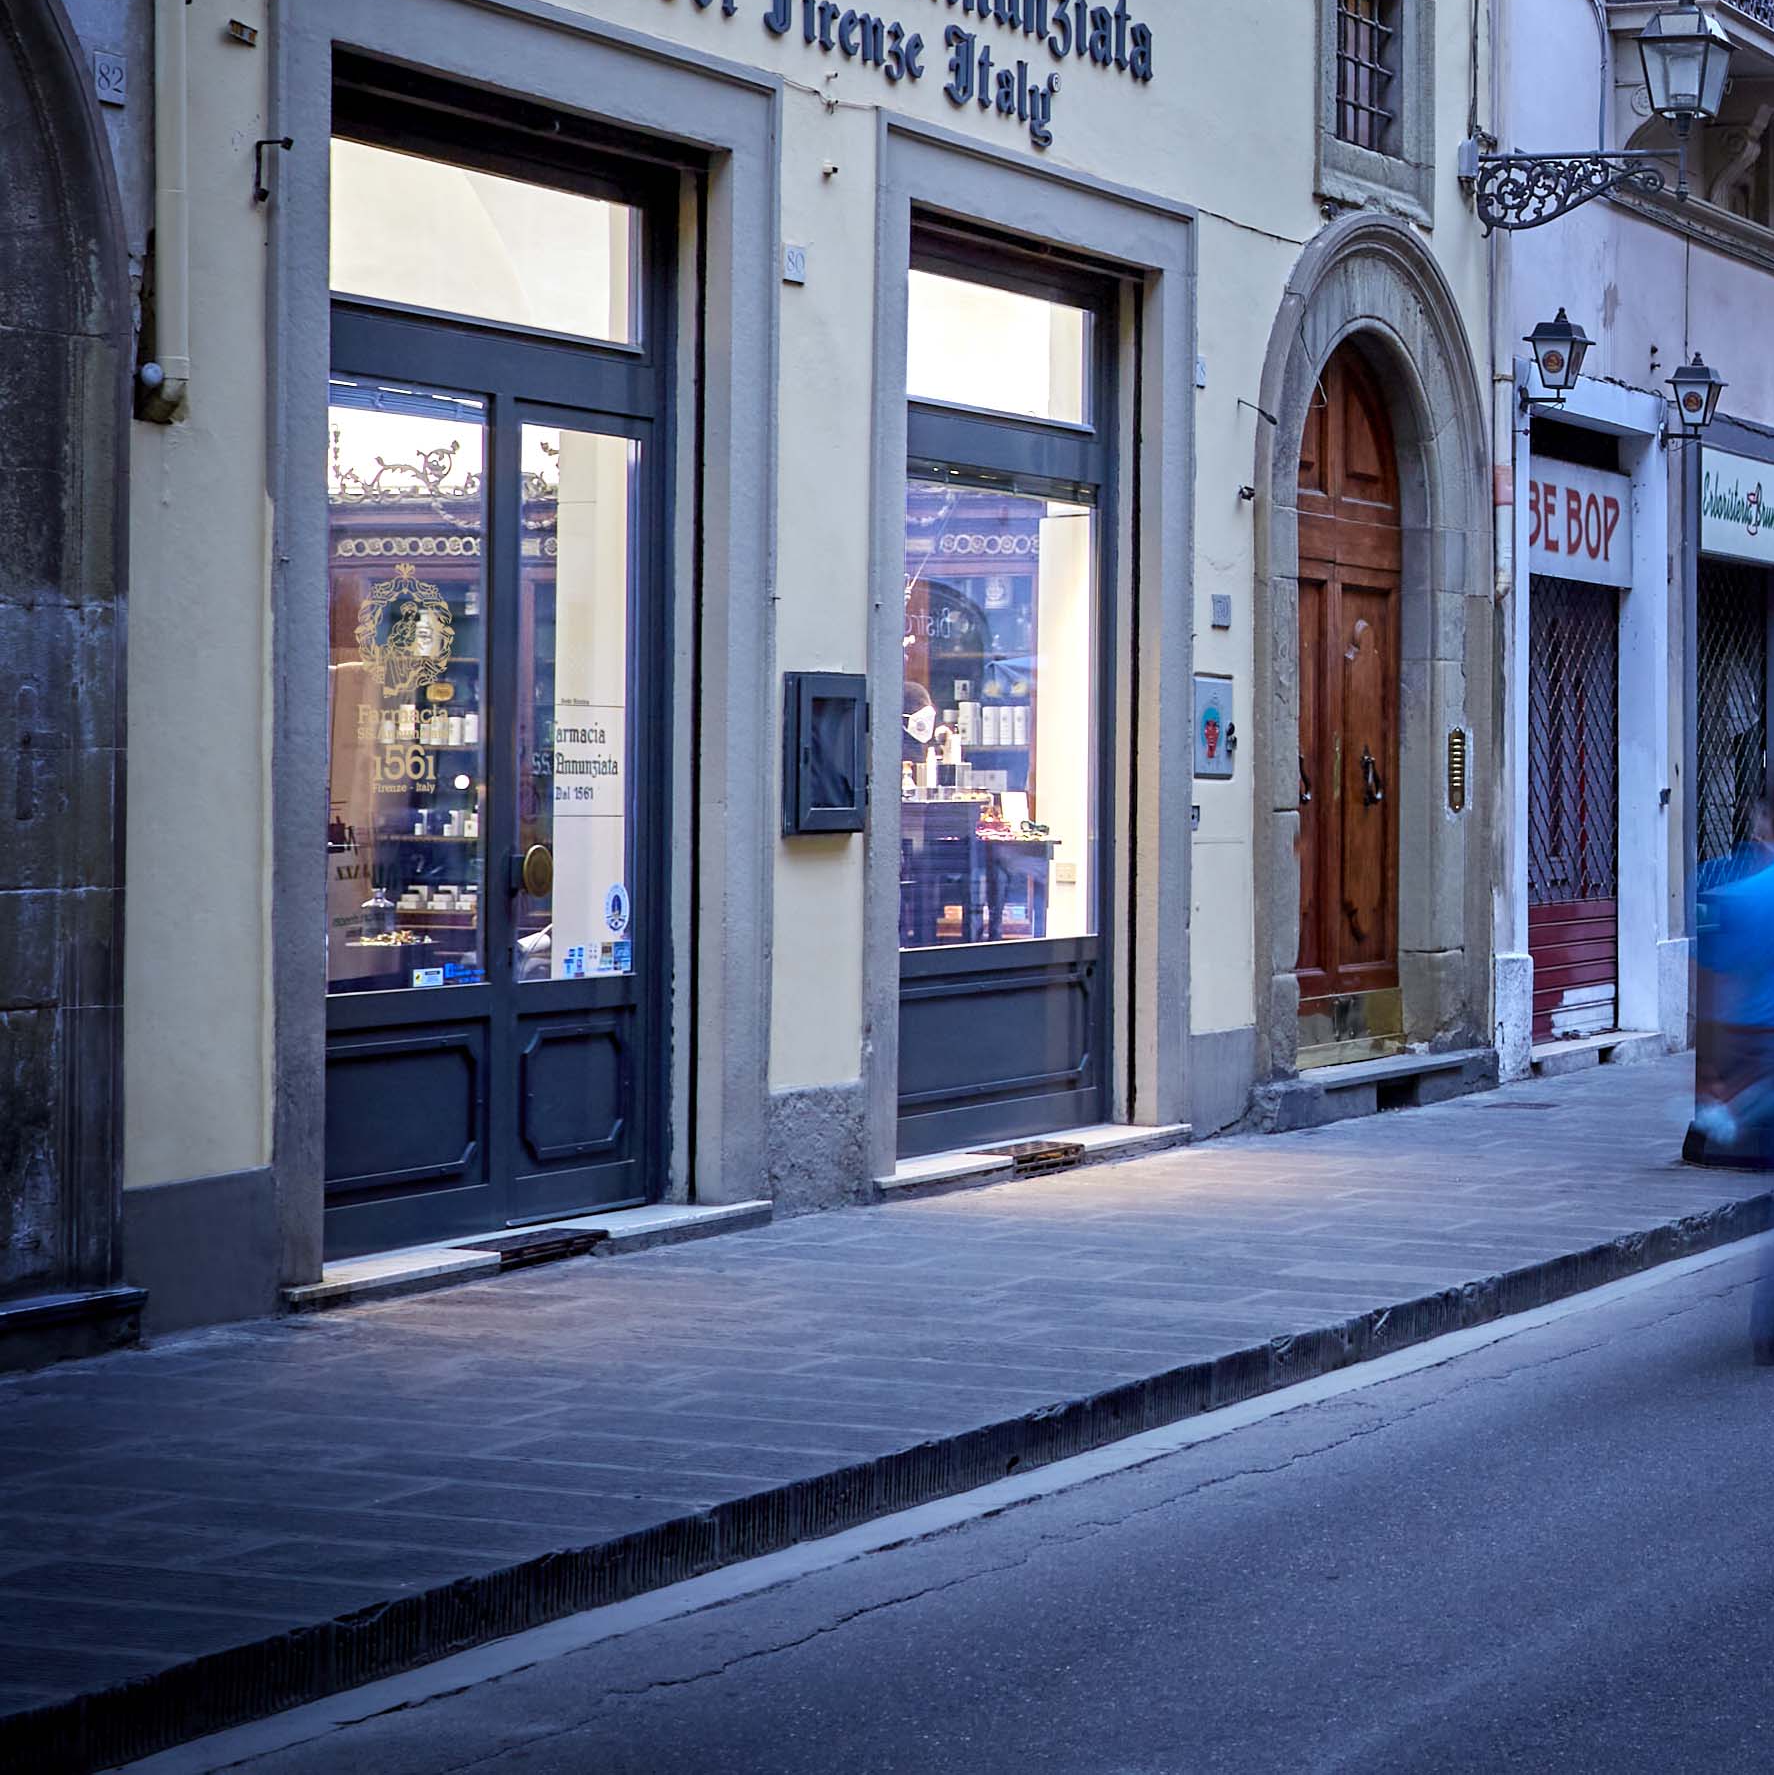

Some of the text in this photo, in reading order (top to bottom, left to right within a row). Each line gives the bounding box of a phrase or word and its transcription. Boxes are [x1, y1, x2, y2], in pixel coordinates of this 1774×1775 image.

[98, 62, 124, 94] 82
[787, 249, 805, 274] 80
[1530, 479, 1620, 562] BE BOP
[358, 704, 449, 724] Farmacia
[373, 744, 436, 781] 1561
[371, 783, 407, 793] Firenze
[416, 782, 436, 794] Italy
